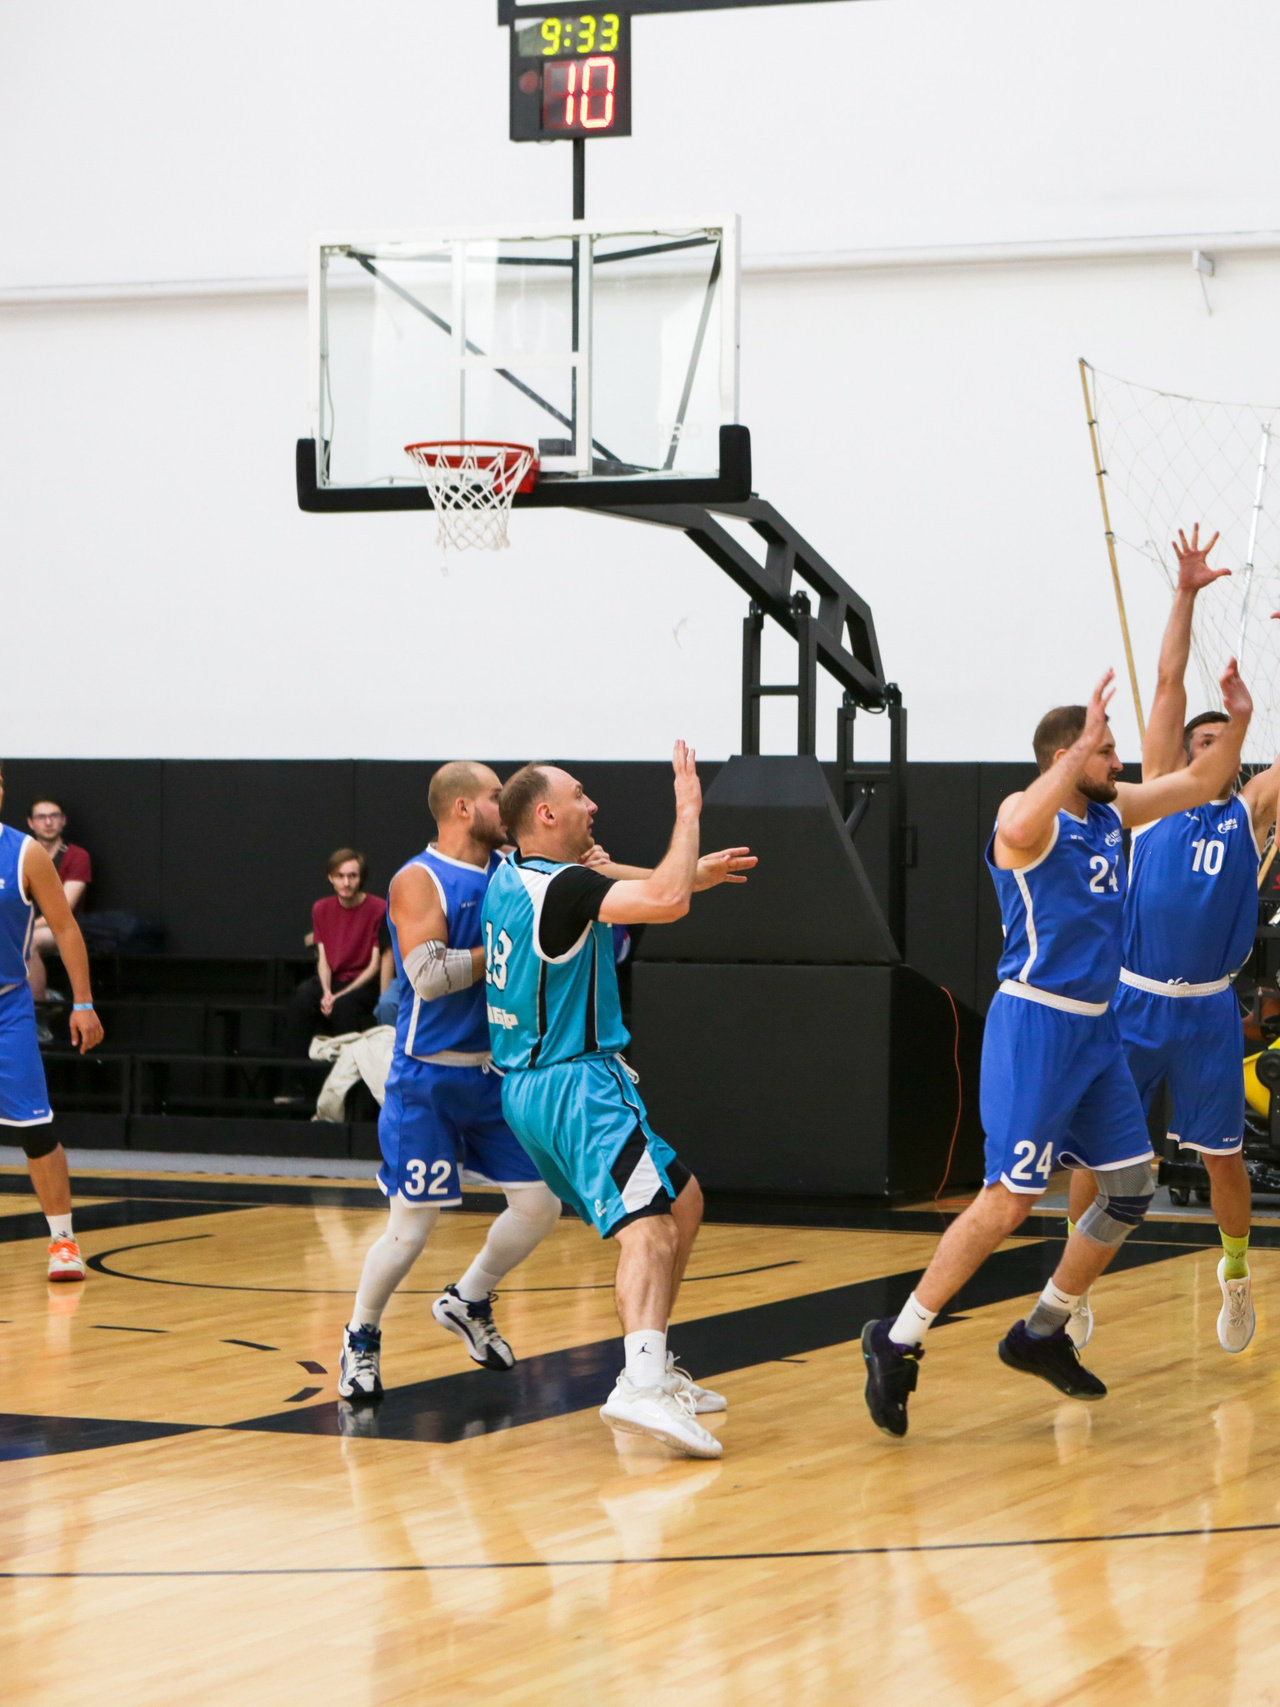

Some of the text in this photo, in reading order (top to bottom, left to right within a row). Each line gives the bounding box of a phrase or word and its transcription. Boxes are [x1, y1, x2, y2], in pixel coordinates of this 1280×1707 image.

[541, 13, 620, 56] 9:33
[565, 56, 616, 129] 10
[1191, 838, 1225, 876] 10
[404, 1158, 452, 1196] 32
[1010, 1140, 1053, 1180] 24
